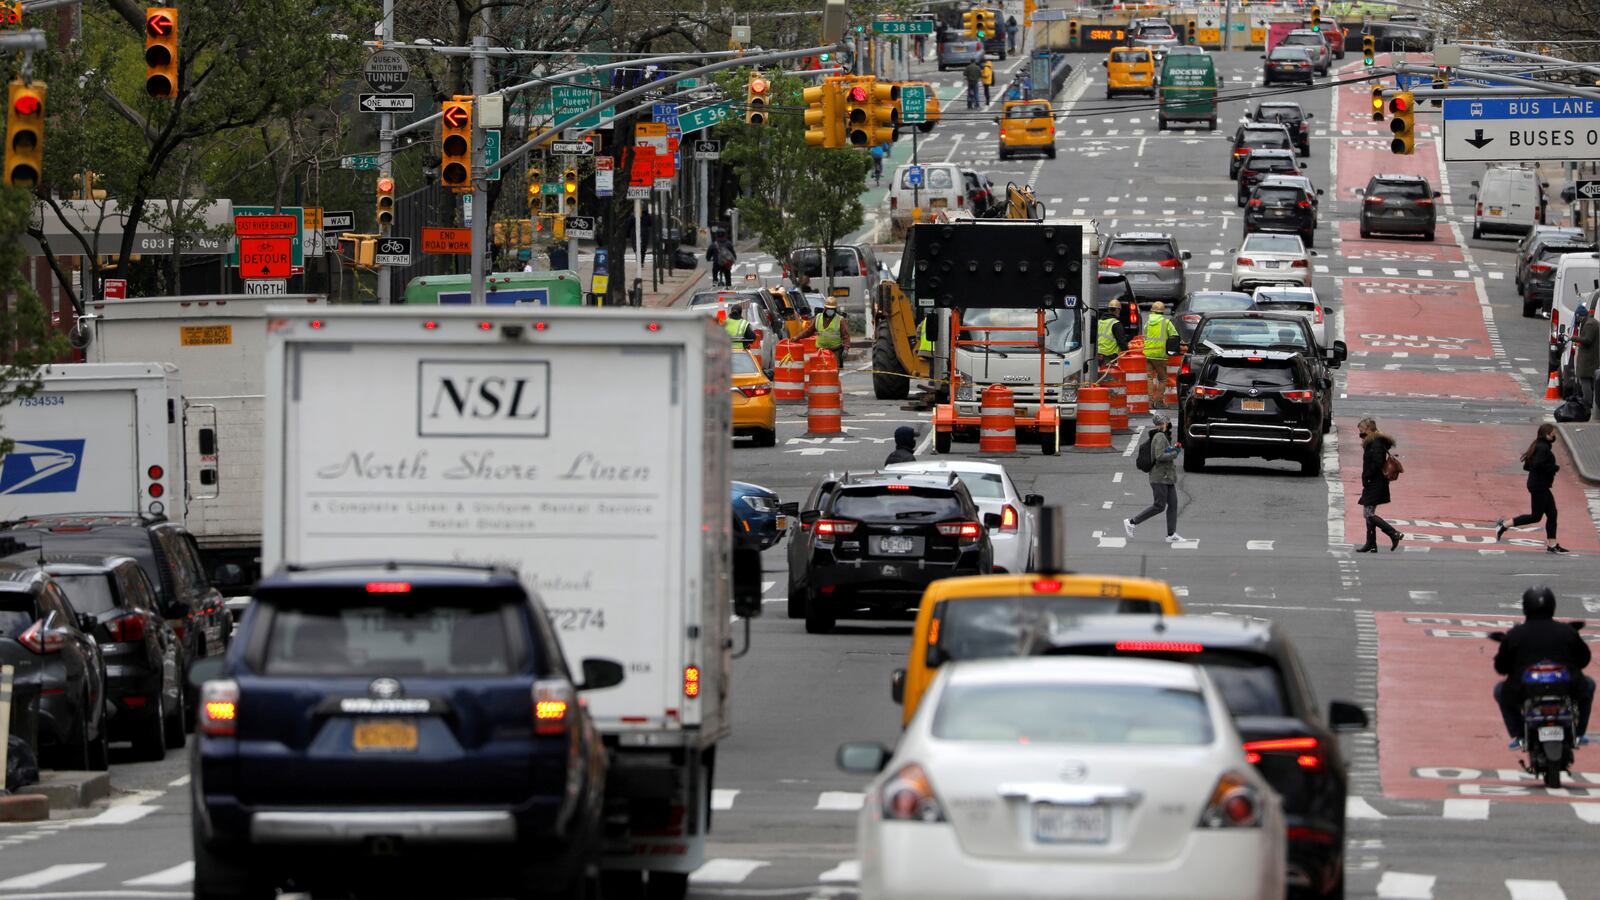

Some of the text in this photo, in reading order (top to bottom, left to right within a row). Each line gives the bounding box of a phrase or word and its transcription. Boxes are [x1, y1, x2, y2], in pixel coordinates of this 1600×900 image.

[882, 23, 922, 32] E 38 St
[366, 73, 406, 82] TUNNEL
[559, 88, 593, 97] Alt Route
[366, 99, 406, 107] ONE WAY
[1509, 101, 1594, 115] BUS LANE
[694, 107, 726, 125] E 36
[1509, 129, 1575, 147] BUSES
[1584, 185, 1600, 194] ONE
[330, 217, 347, 226] WAY
[439, 231, 456, 240] END
[141, 238, 165, 249] 603
[199, 238, 220, 249] Ave
[425, 240, 469, 249] ROAD WORK
[243, 253, 288, 264] DETOUR
[376, 255, 408, 263] BIKE PATH
[247, 283, 284, 295] NORTH
[1066, 297, 1076, 306] W
[1359, 333, 1478, 344] ONLY
[17, 395, 65, 408] 7534534
[428, 376, 541, 421] NSL
[316, 449, 651, 481] North Shore Linen
